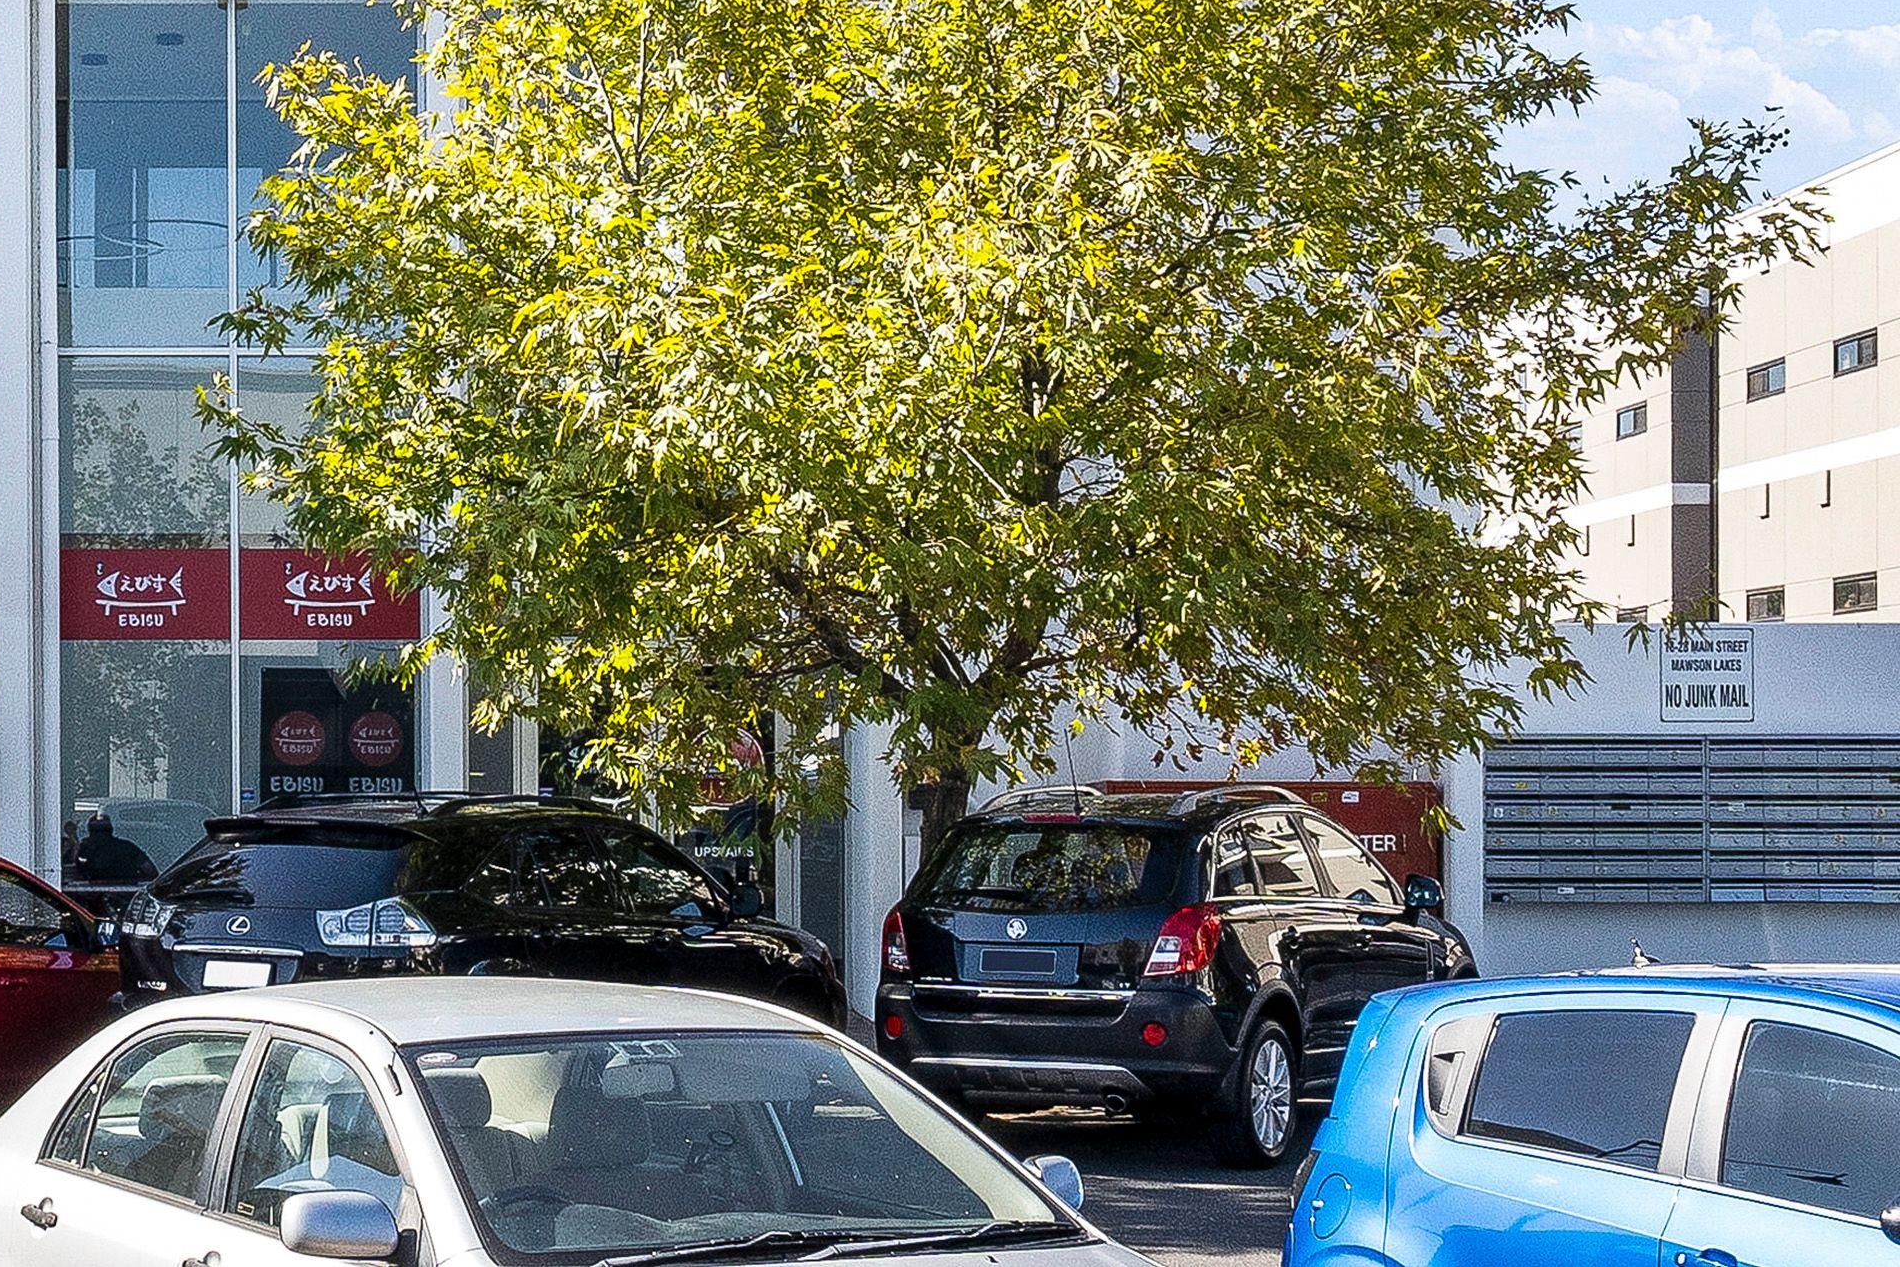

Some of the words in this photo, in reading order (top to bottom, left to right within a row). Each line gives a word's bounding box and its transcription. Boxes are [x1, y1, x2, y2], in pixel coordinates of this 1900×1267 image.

[120, 573, 167, 593] えびす
[308, 573, 356, 593] えびす
[118, 613, 164, 627] EBISU
[306, 613, 353, 627] EBISU
[1691, 640, 1714, 652] MAIN
[1715, 640, 1749, 652] STREET
[1671, 659, 1713, 671] MAWSON
[1713, 659, 1742, 671] LAKES
[1665, 684, 1682, 708] NO
[1684, 684, 1717, 708] JUNK
[1719, 684, 1749, 708] MAIL
[269, 776, 325, 793] EBISU
[349, 776, 404, 793] EBISU
